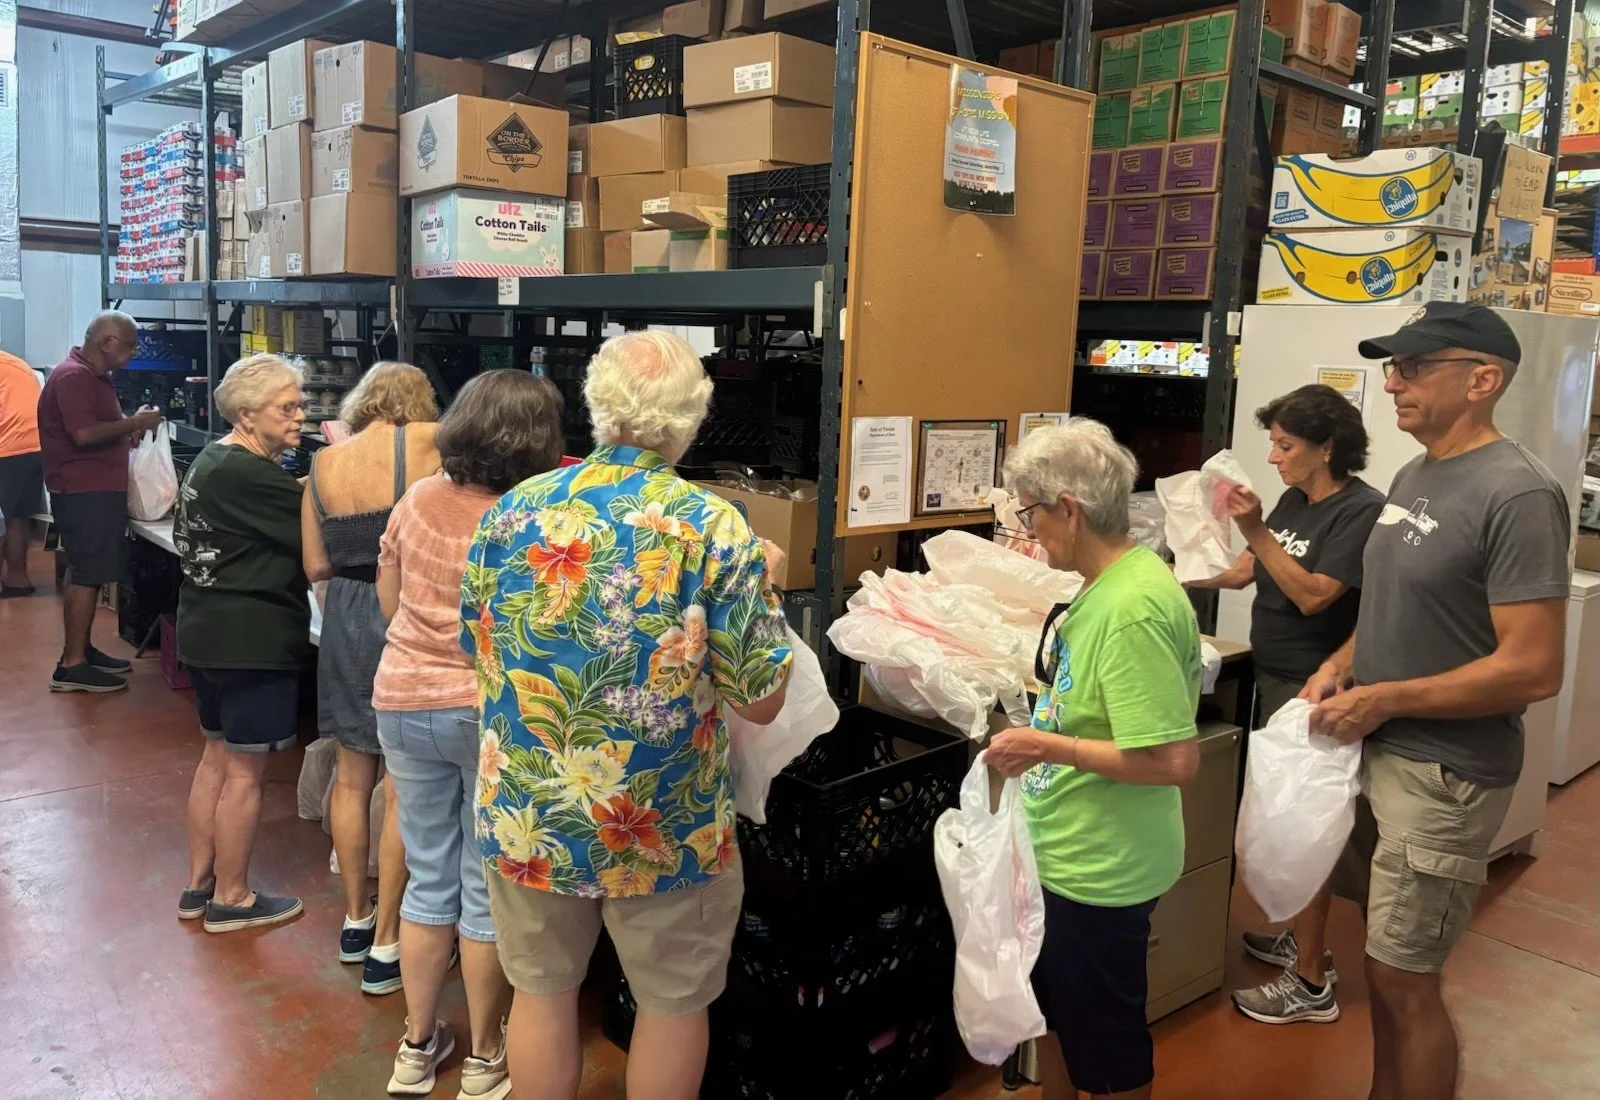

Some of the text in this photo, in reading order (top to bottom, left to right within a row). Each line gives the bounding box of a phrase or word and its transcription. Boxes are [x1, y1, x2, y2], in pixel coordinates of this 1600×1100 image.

[497, 134, 532, 147] BORDER
[513, 131, 526, 139] THE
[1385, 191, 1418, 214] Chiquita
[475, 215, 547, 233] Cotton Tails
[1366, 273, 1396, 294] Chiquita
[1269, 528, 1311, 558] didas
